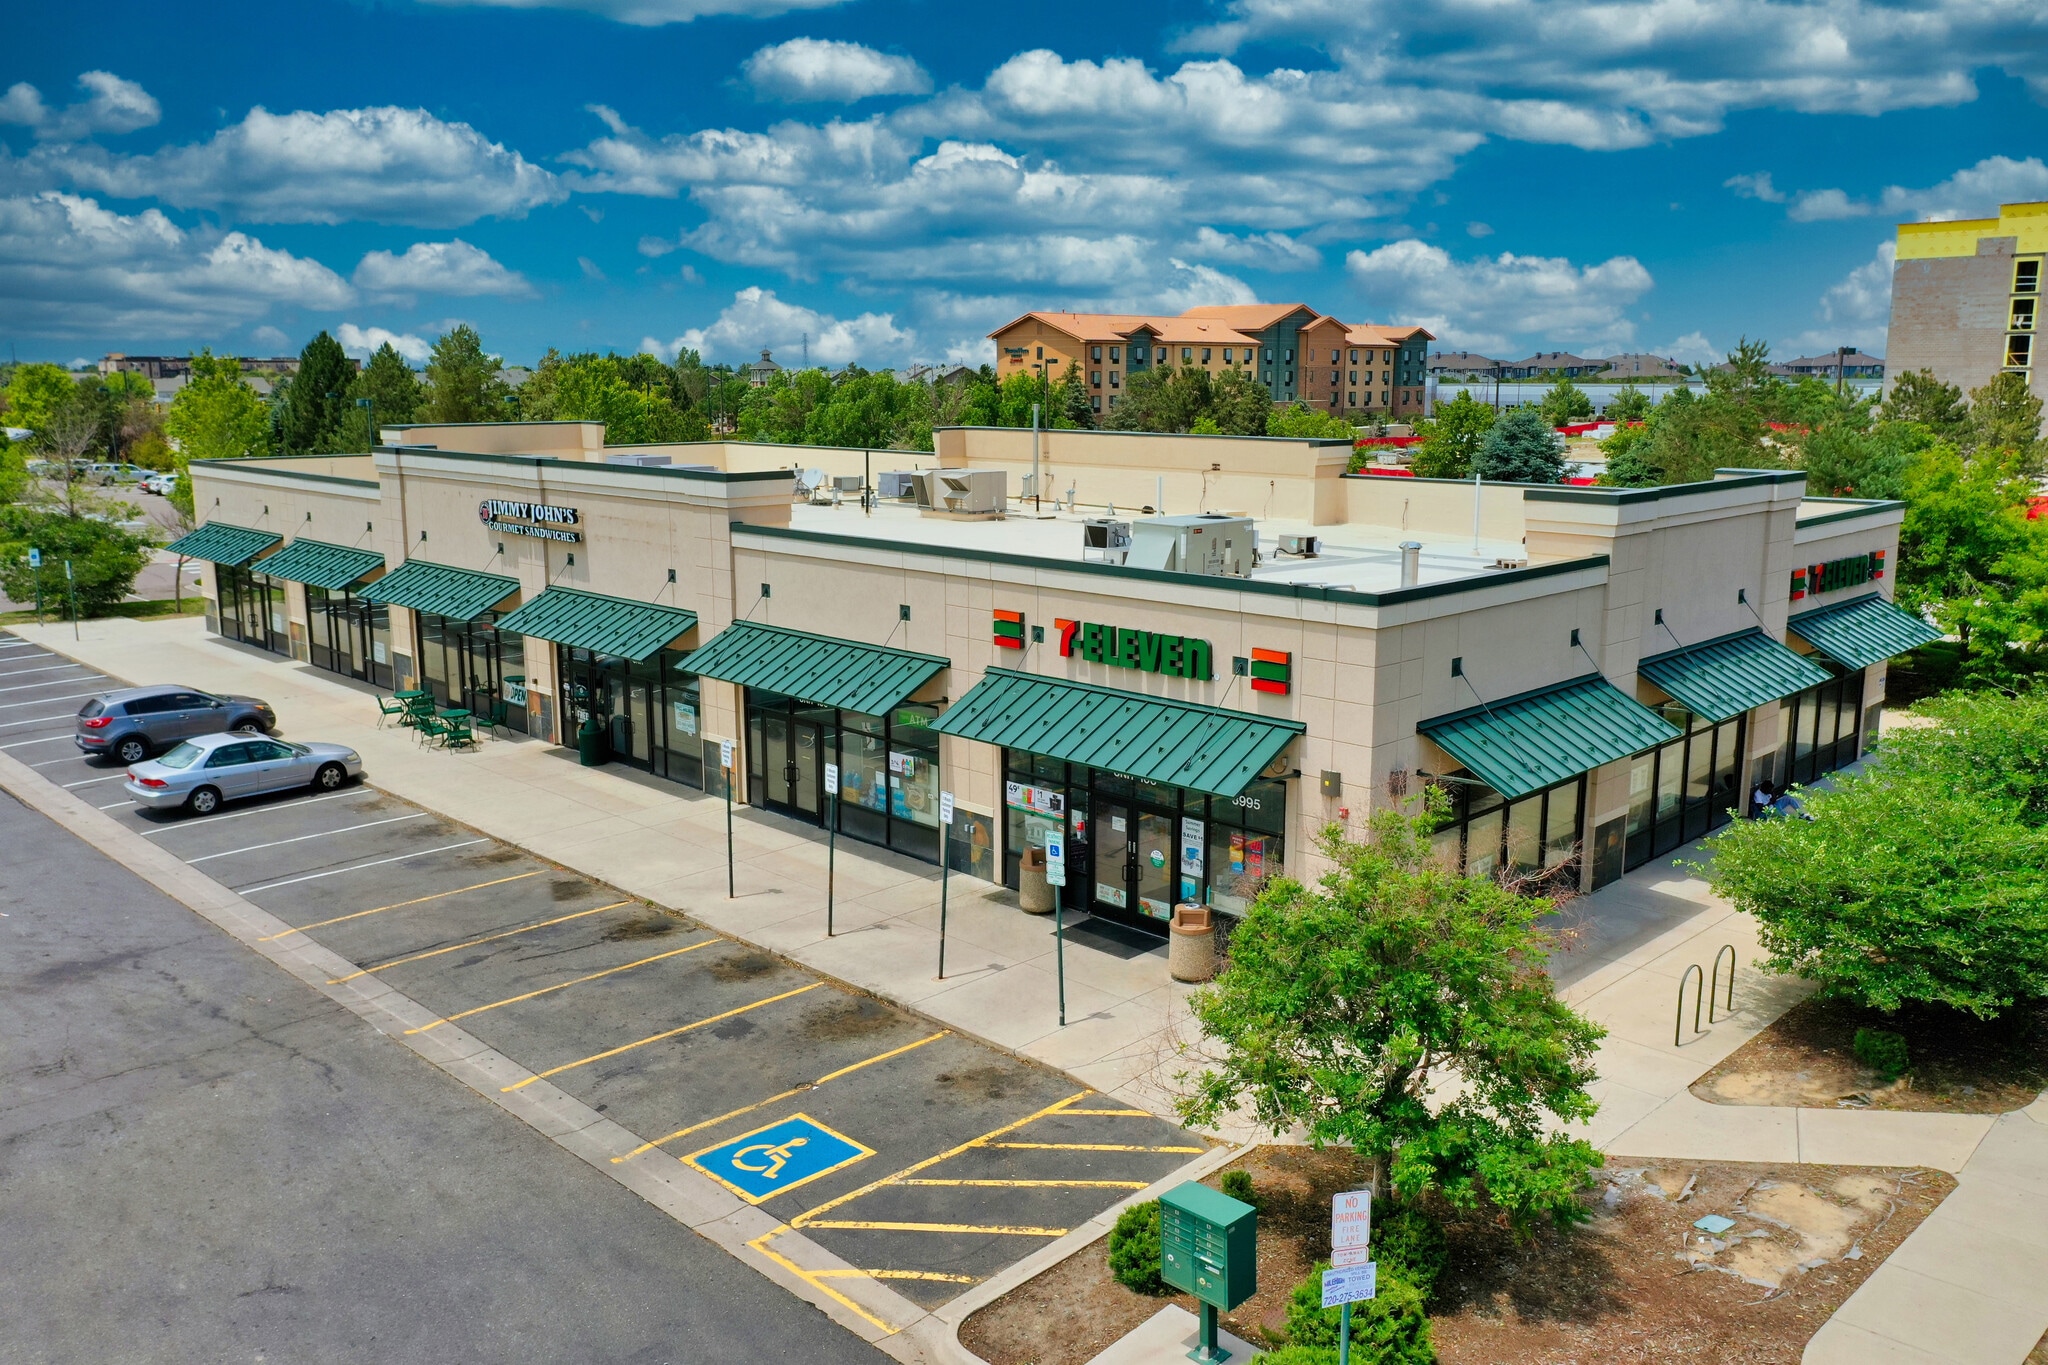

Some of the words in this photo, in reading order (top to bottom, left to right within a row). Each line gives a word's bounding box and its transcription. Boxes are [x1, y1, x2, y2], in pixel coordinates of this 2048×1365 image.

[488, 499, 528, 519] JIMMY
[530, 504, 575, 525] JOHN'S
[488, 521, 524, 535] GOURMET
[524, 526, 576, 543] SANDWICHES
[511, 686, 526, 702] OPEN
[909, 714, 928, 727] ATM
[1182, 832, 1198, 840] SAVE
[1346, 1198, 1358, 1208] NO
[1336, 1211, 1367, 1223] PARKING
[1342, 1225, 1360, 1234] FIRE
[1340, 1235, 1360, 1243] LANE
[1348, 1273, 1371, 1282] TOWED
